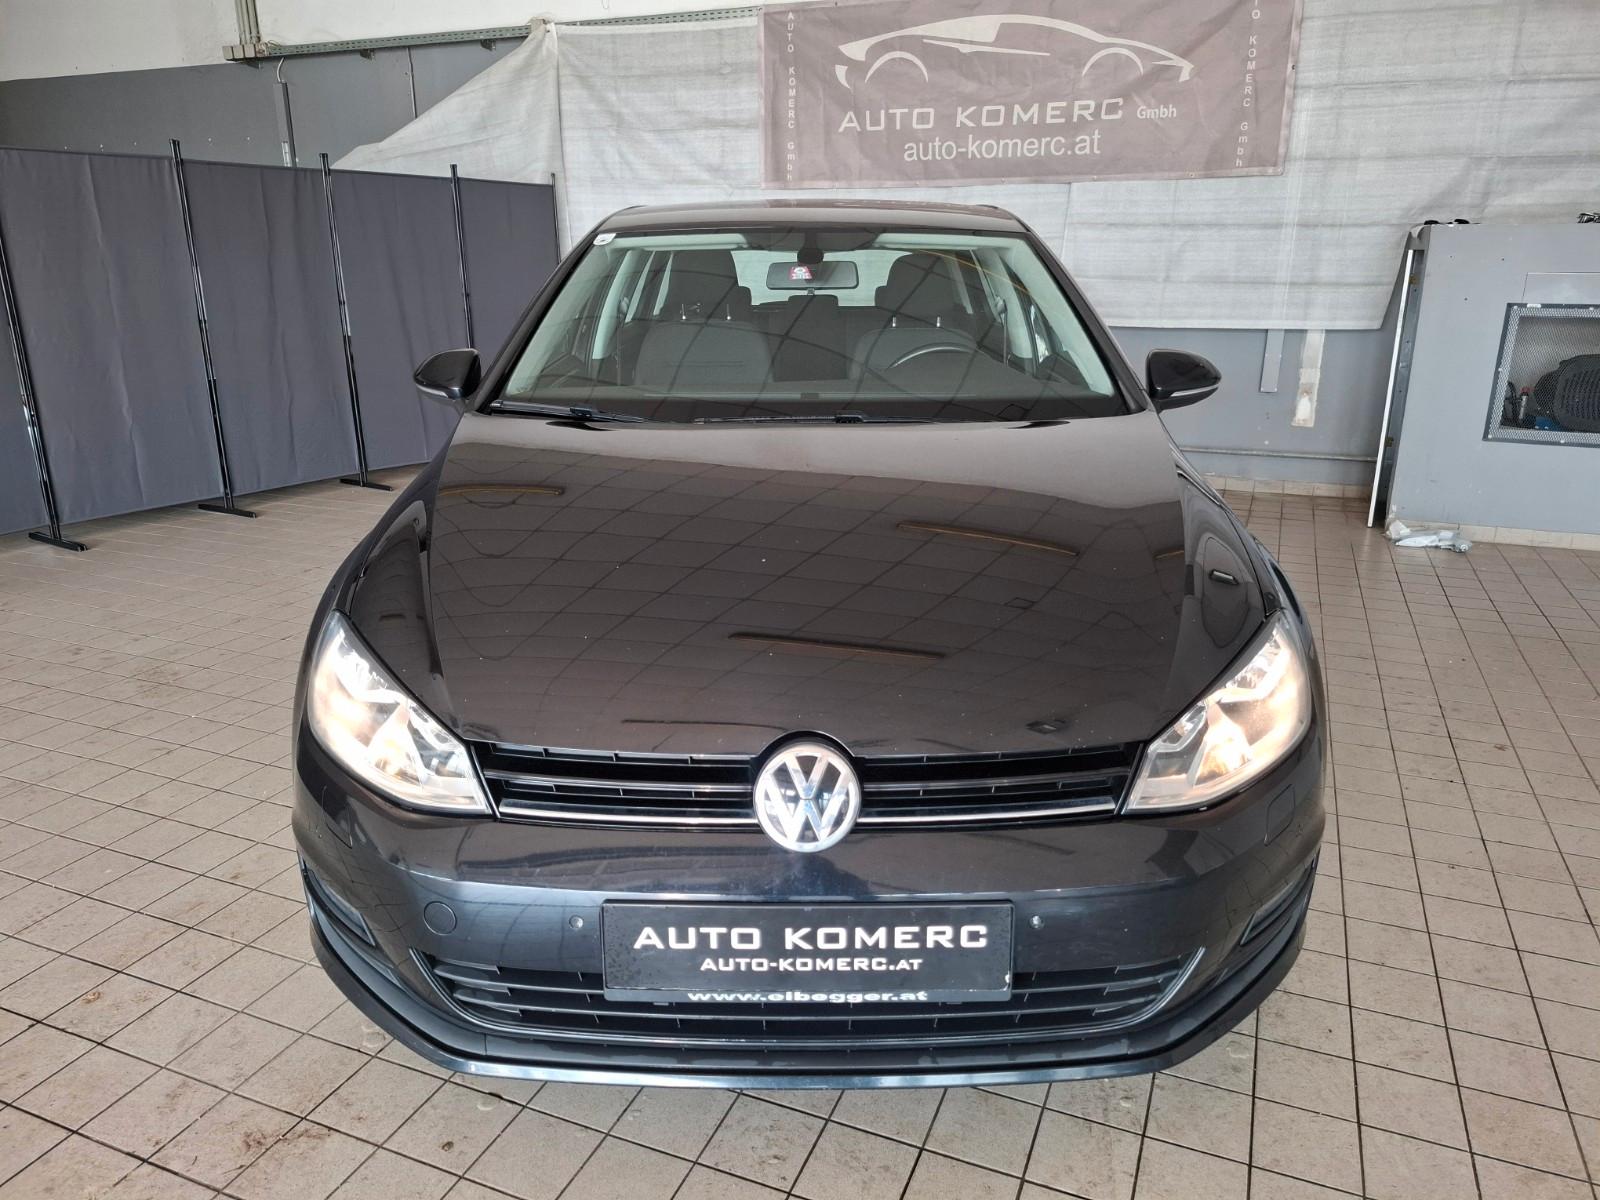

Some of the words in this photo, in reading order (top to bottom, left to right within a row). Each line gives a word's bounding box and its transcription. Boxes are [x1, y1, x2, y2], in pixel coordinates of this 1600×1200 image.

[787, 12, 795, 53] AUTO
[1243, 35, 1257, 107] KOMERC
[788, 67, 796, 129] KOMERC
[838, 106, 936, 133] AUTO
[955, 97, 1124, 128] KOMERC
[1136, 104, 1177, 120] Gmbh
[903, 128, 1102, 162] auto-komerc.at
[633, 926, 762, 950] AUTO
[784, 924, 989, 950] KOMERC
[700, 956, 924, 972] AUTO-KOMERC.AT
